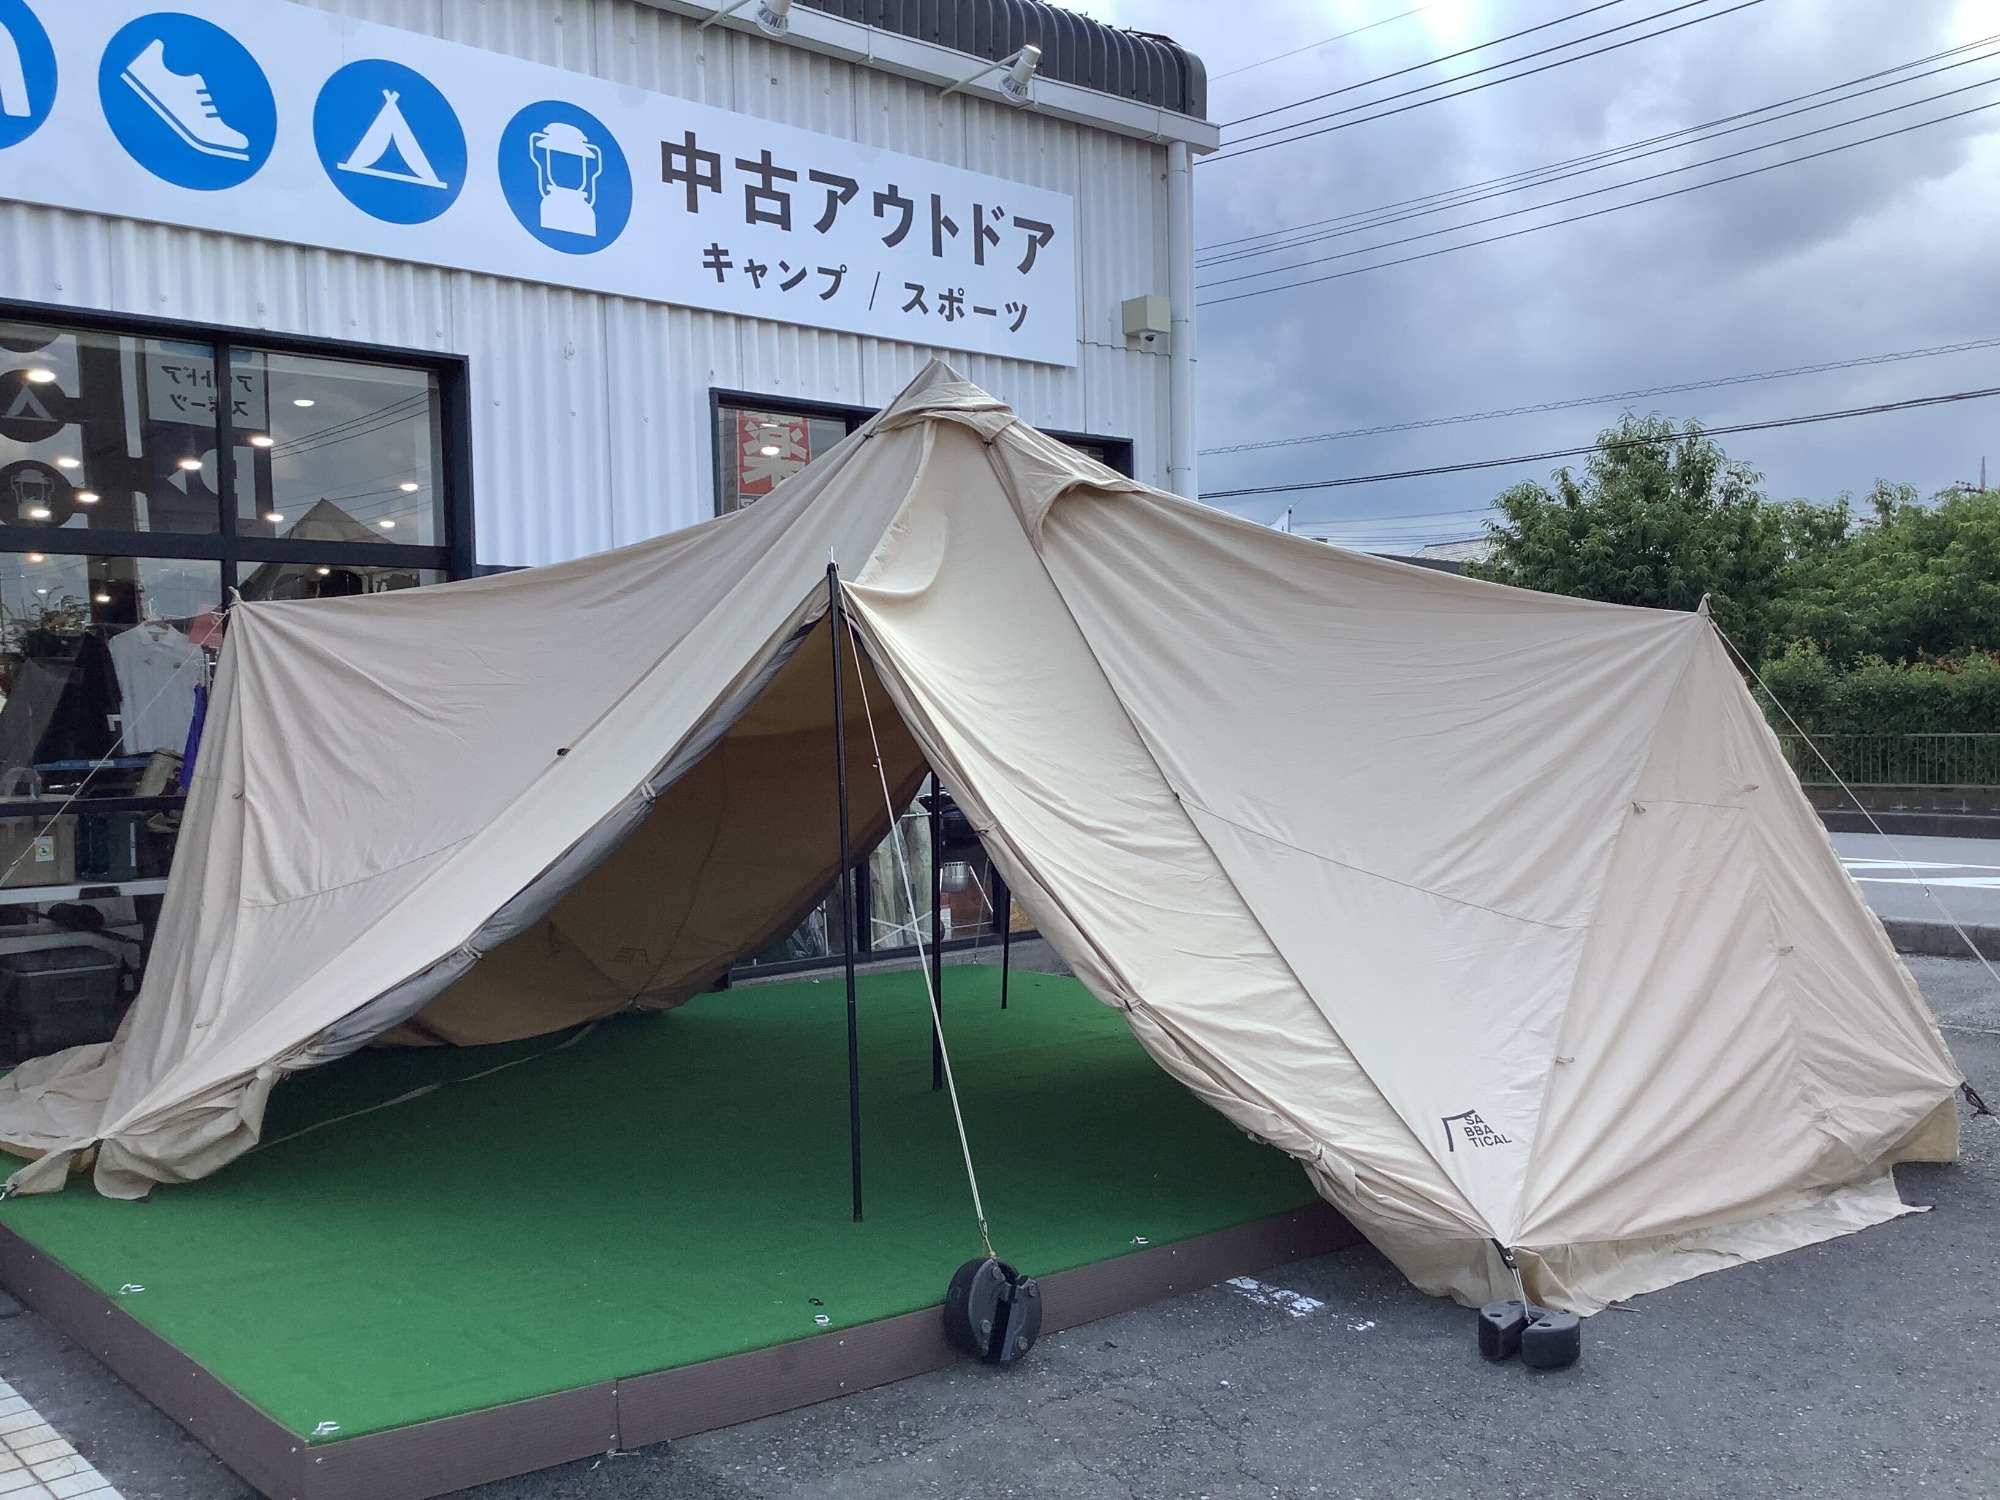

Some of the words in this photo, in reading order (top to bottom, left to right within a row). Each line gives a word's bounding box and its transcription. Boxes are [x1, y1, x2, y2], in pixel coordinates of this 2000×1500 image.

[660, 130, 1055, 275] 中古アウトドア
[702, 242, 848, 301] キャンプ
[868, 271, 881, 311] /
[902, 281, 1029, 333] スポーツ
[1463, 1114, 1484, 1125] SA
[1463, 1125, 1494, 1137] BBA
[1468, 1134, 1512, 1147] TICAL
